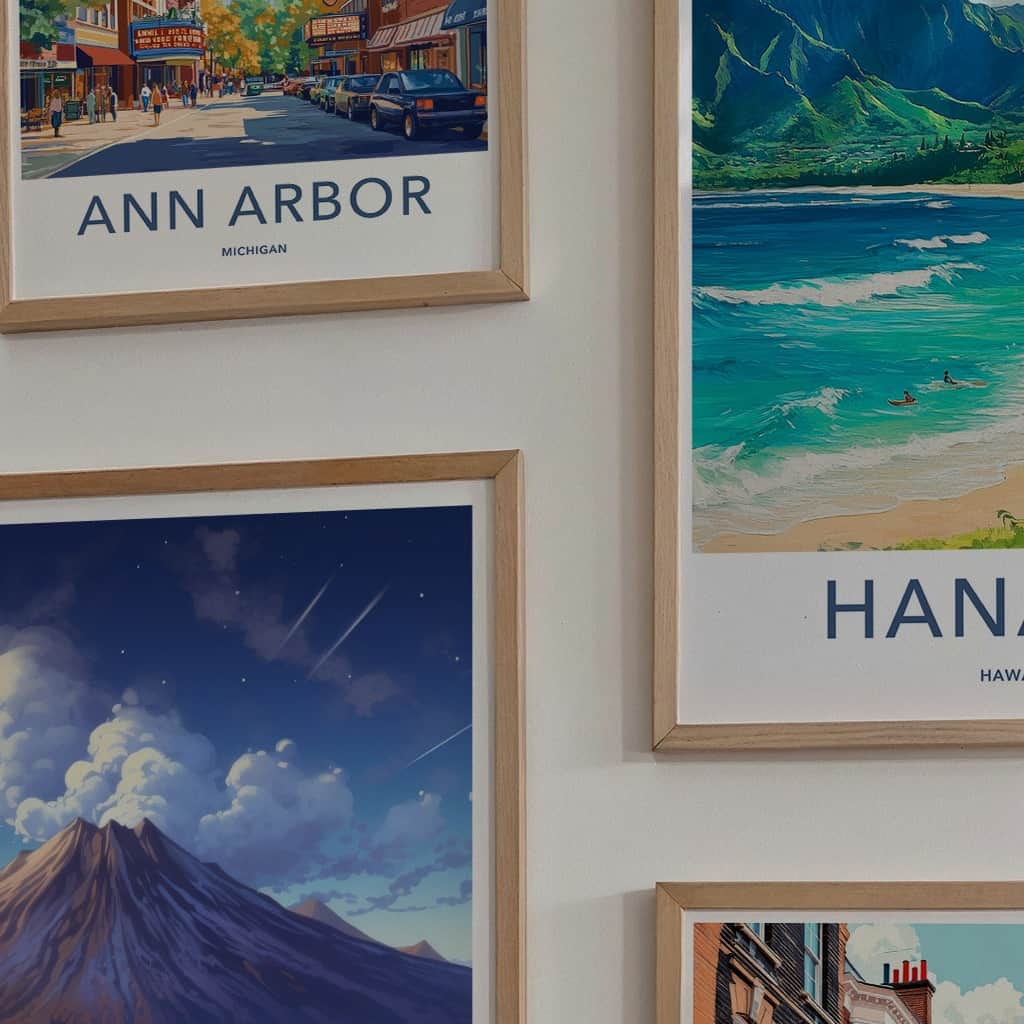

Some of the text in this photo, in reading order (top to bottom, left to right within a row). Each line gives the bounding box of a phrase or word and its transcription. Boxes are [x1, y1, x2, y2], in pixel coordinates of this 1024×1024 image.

[77, 175, 432, 236] ANN ARBOR
[221, 244, 287, 257] MICHIGAN
[826, 577, 1024, 639] HAN
[980, 668, 1024, 682] HAW
